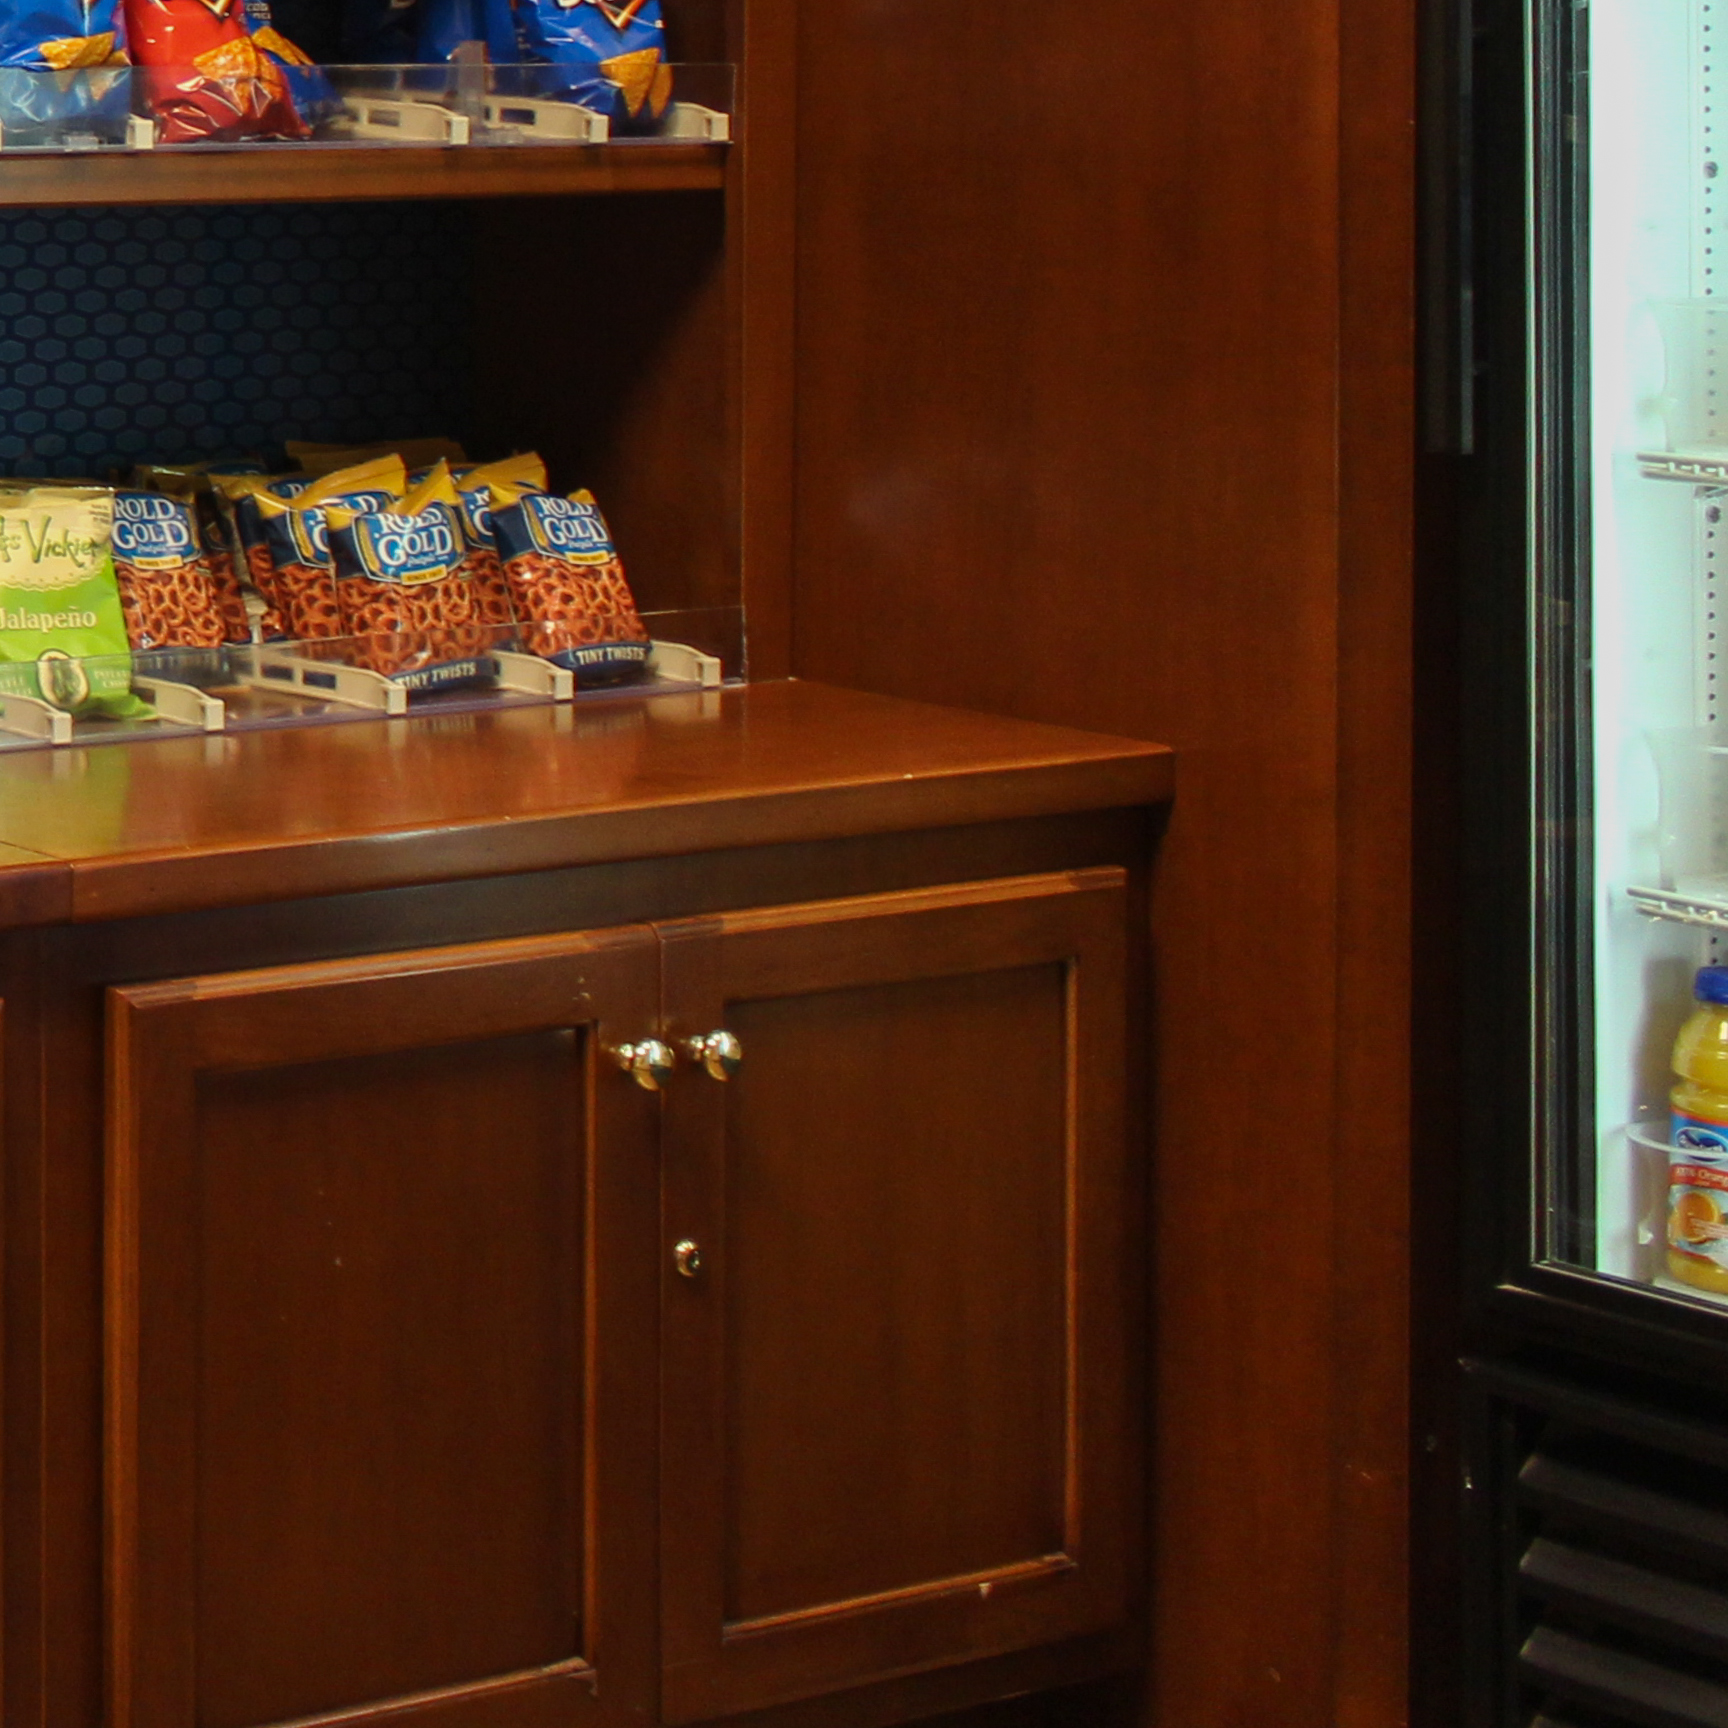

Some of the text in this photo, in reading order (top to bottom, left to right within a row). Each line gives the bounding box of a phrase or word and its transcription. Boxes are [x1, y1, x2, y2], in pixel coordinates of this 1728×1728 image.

[114, 496, 177, 522] ROLD
[539, 496, 594, 518] ROLD
[111, 520, 190, 550] GOLD
[544, 516, 610, 546] GOLD
[377, 526, 453, 566] GOLD
[574, 645, 646, 665] TINY TWISTS
[395, 662, 477, 690] TINY TWISTS
